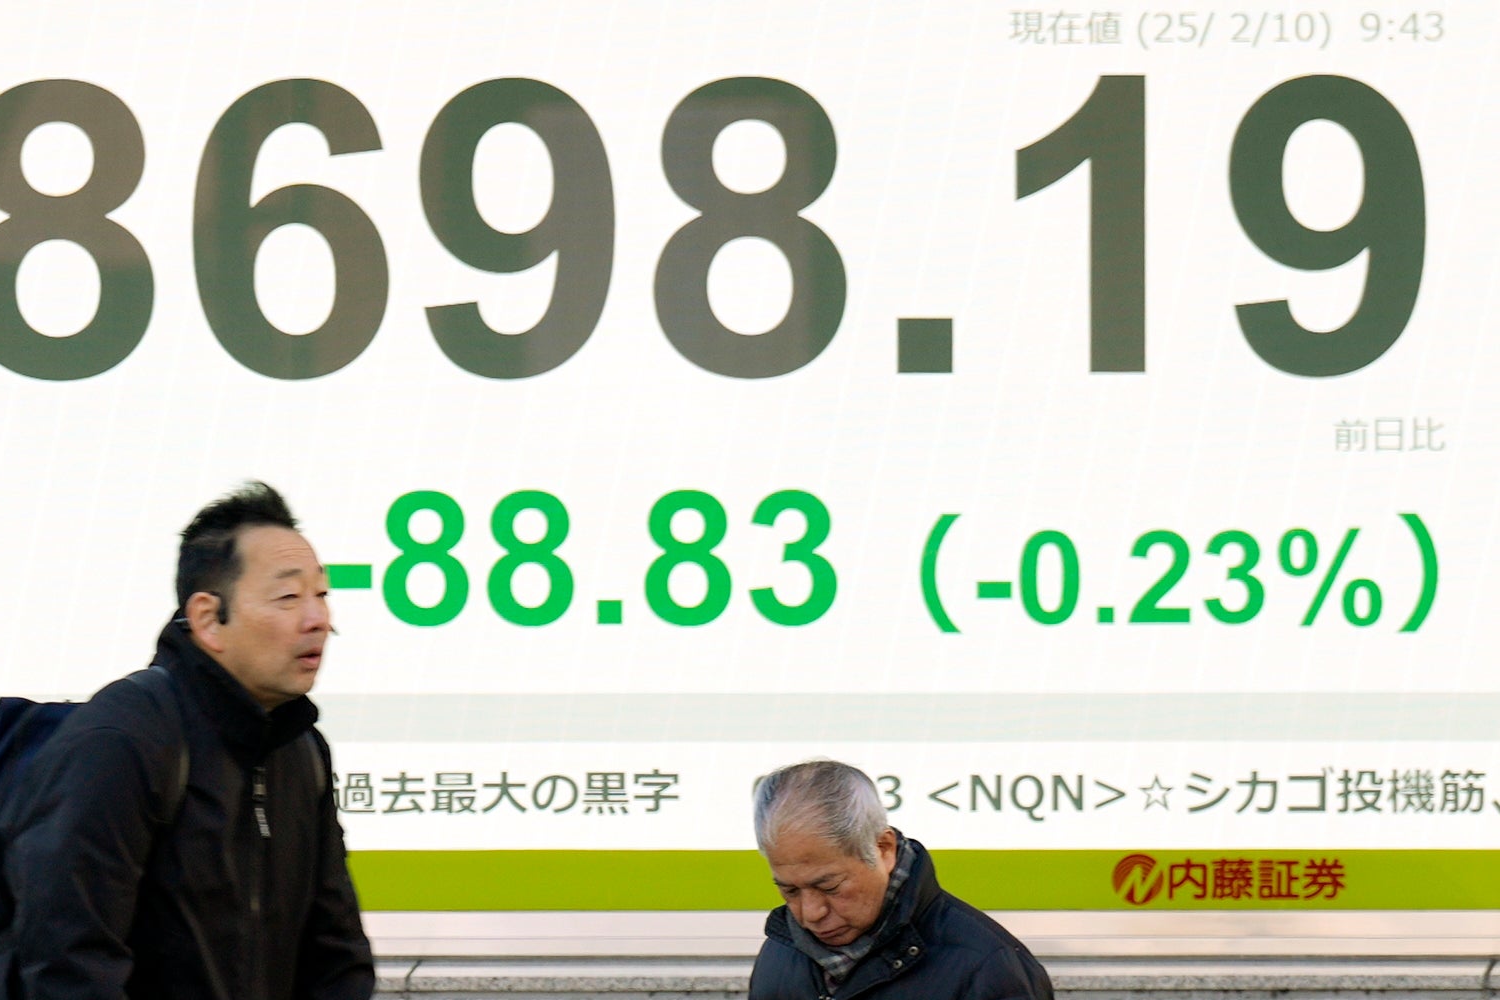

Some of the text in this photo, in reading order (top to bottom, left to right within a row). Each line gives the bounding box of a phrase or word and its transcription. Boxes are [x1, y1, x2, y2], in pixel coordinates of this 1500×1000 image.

[1010, 11, 1445, 49] 現在値 (25/ 2/10) 9:43
[1334, 417, 1446, 452] 前日比
[324, 489, 1439, 634] -88.83 (-0.23%)
[332, 769, 680, 815] 過去最大の黒字
[1168, 858, 1346, 900] 内藤証券
